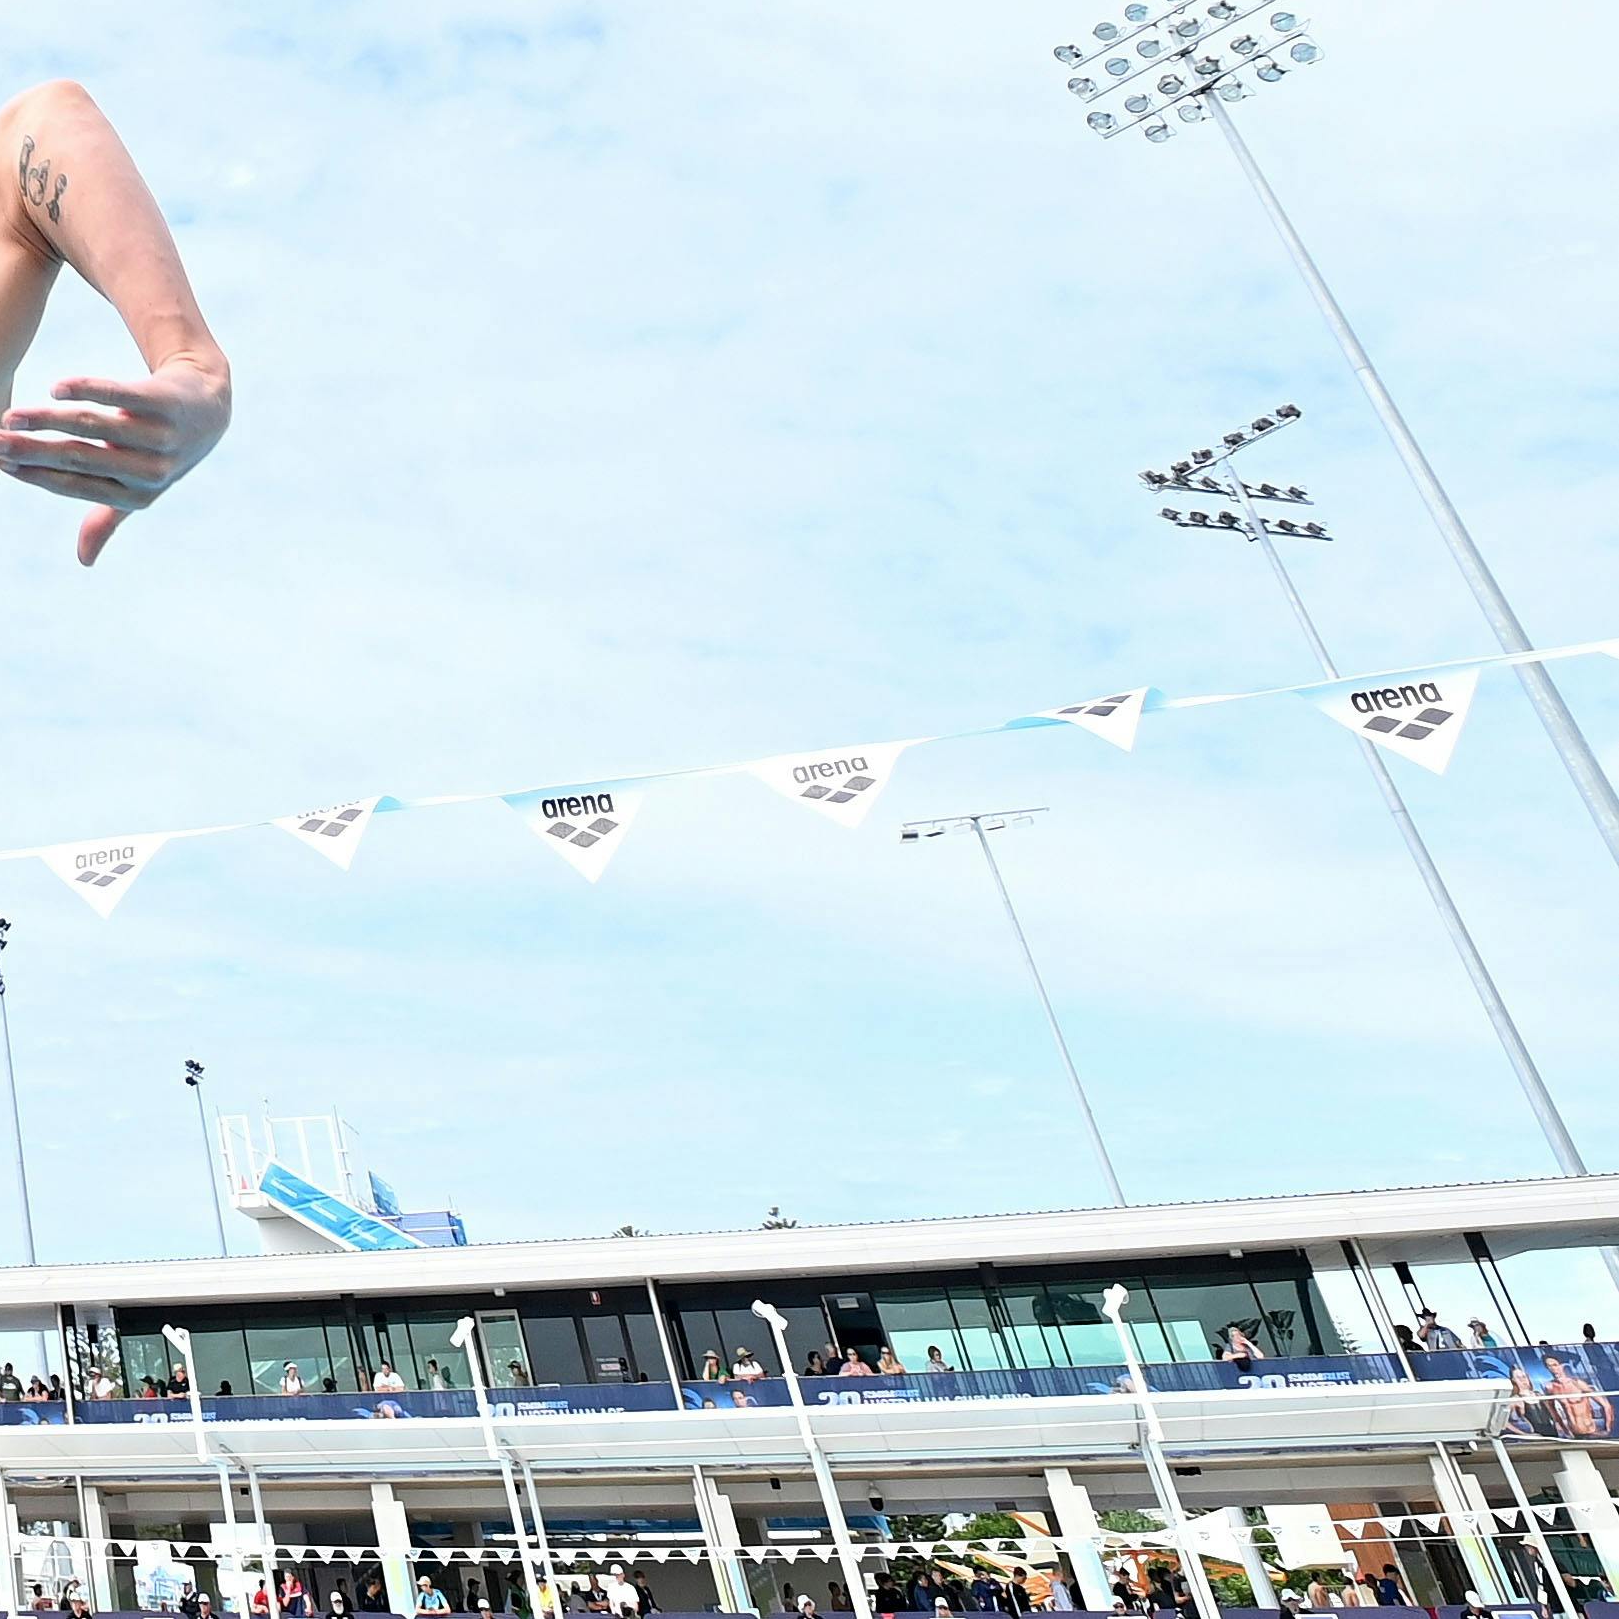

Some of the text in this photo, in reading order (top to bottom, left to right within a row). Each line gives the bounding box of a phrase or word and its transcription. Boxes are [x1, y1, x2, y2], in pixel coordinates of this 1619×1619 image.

[1350, 679, 1443, 714] arena
[793, 754, 869, 783] arena
[542, 791, 614, 820] arena
[75, 844, 135, 869] arena
